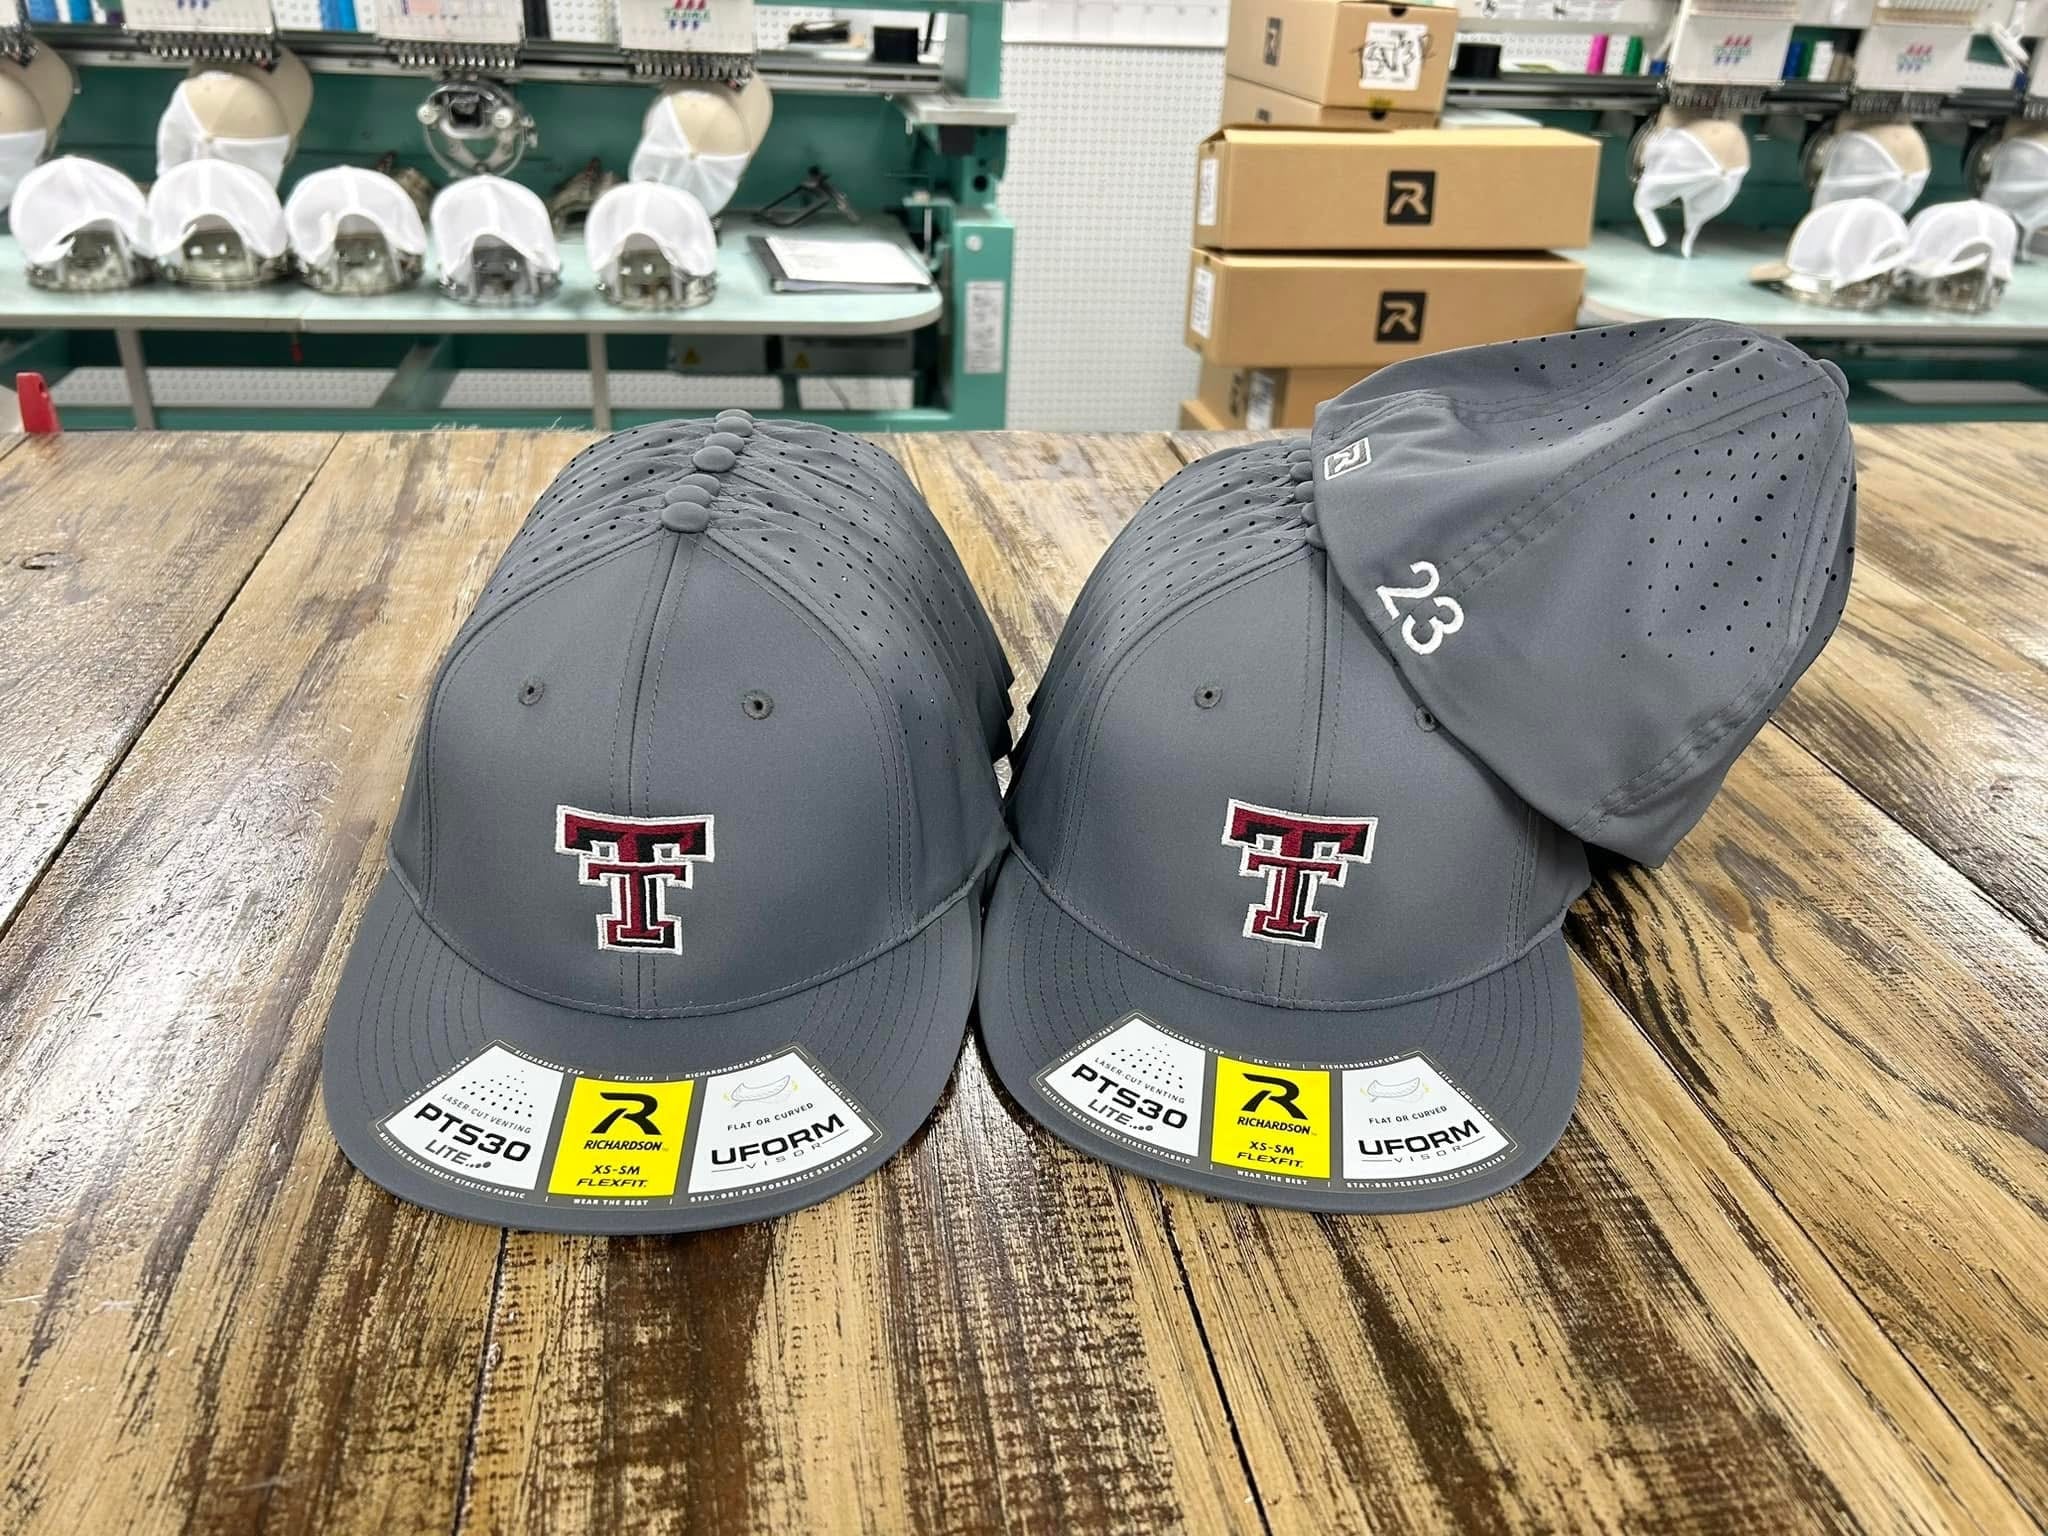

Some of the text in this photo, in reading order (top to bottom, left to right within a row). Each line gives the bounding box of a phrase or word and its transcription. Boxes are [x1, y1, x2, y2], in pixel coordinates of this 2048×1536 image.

[1376, 561, 1464, 655] 23
[1071, 1064, 1188, 1129] PTS30
[1144, 1081, 1185, 1104] VENTING
[727, 1102, 814, 1131] FLAT OR CURVED
[1088, 1098, 1133, 1125] LITE
[1369, 1105, 1447, 1125] FLAT OR CURVED
[414, 1102, 533, 1162] PTS30
[489, 1115, 533, 1134] VENTING
[1237, 1116, 1311, 1135] RICHARDSON
[584, 1139, 663, 1151] RICHARDSON
[711, 1113, 845, 1165] UFORM
[1250, 1141, 1295, 1155] XS-SM
[1358, 1119, 1480, 1155] UFORM
[425, 1139, 472, 1165] LITE
[745, 1142, 822, 1170] VISOR
[1393, 1144, 1462, 1163] VISOR
[592, 1165, 641, 1175] XS-SM
[1237, 1170, 1261, 1179] WEAR
[1265, 1174, 1281, 1182] THE
[742, 1172, 814, 1196] PERFORMANCE
